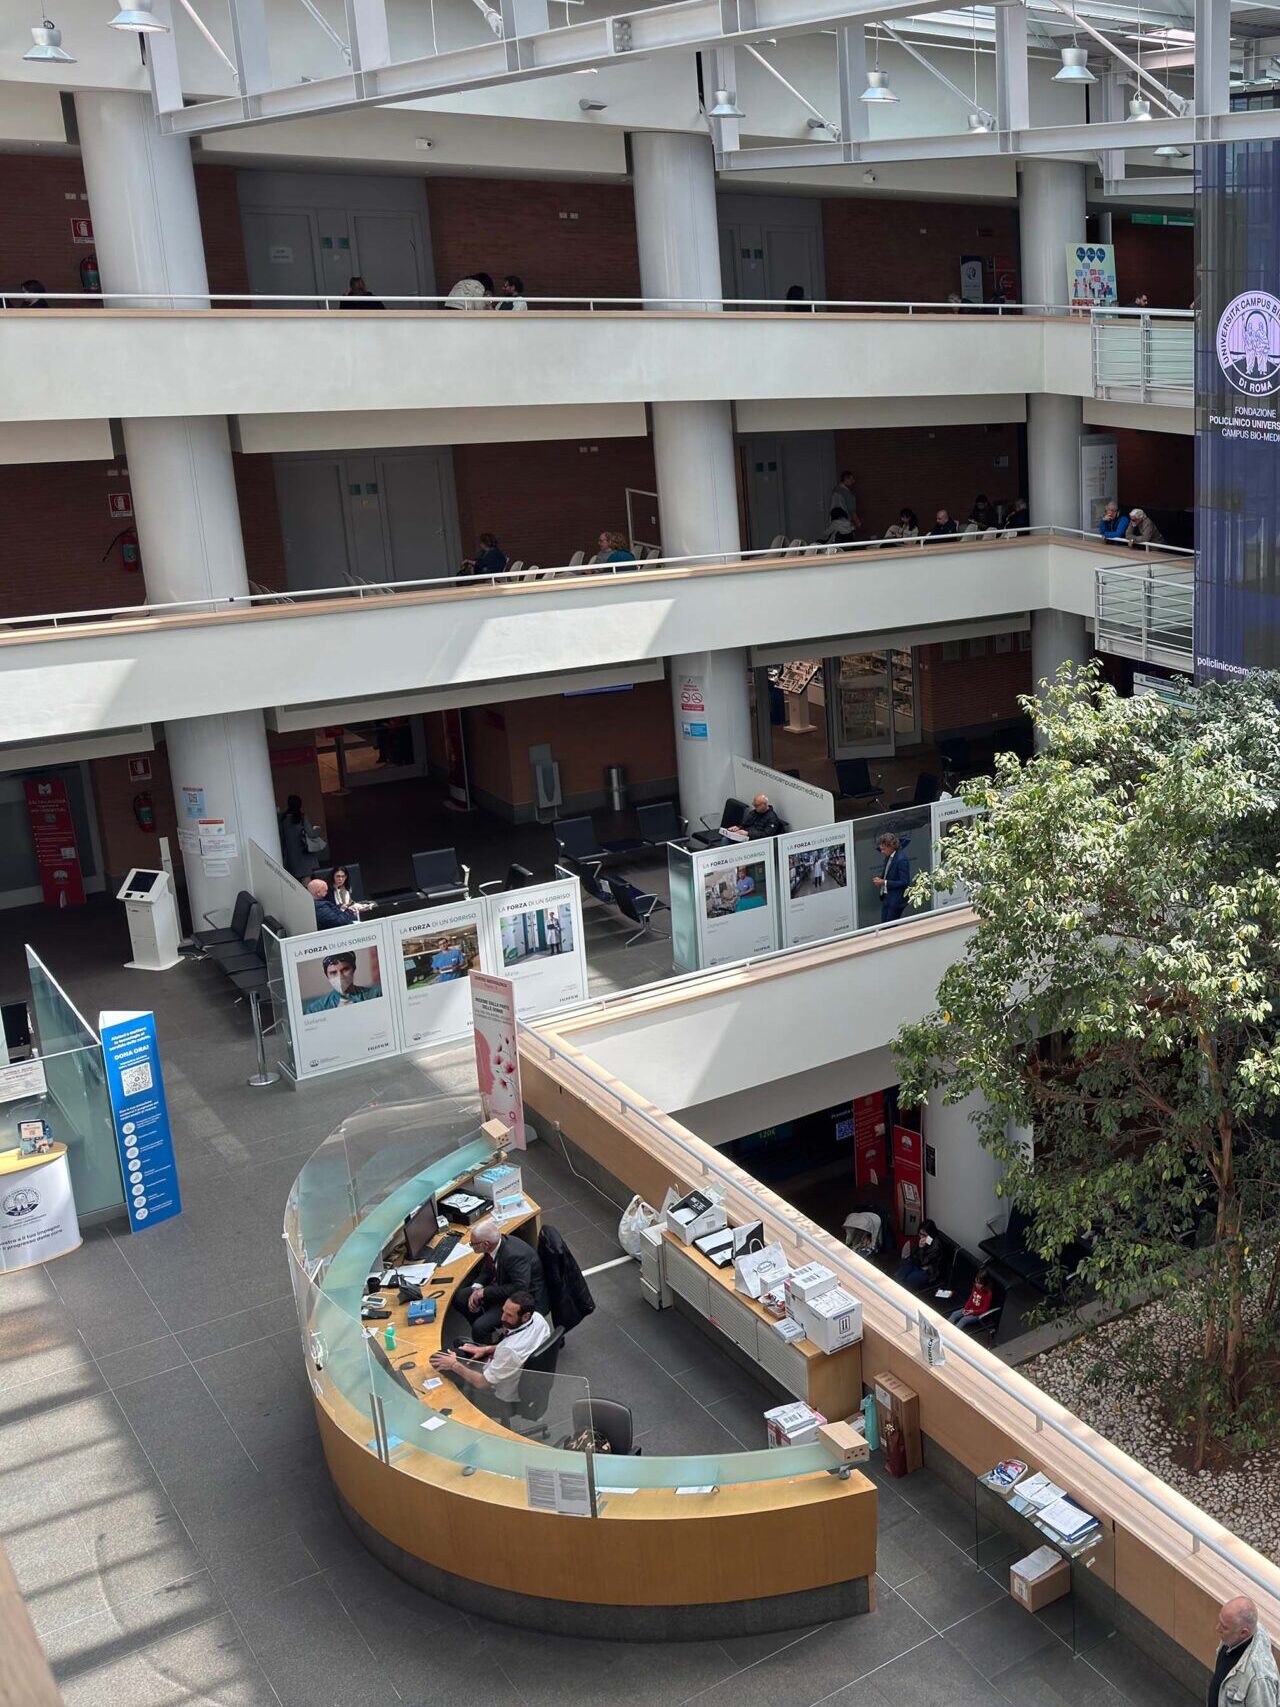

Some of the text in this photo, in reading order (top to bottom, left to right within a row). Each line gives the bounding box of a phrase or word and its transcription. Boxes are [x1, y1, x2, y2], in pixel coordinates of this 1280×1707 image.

[1240, 296, 1272, 310] CAMPUS
[1238, 377, 1273, 393] DI ROMA
[1234, 406, 1276, 418] FONDAZIONE
[1210, 416, 1250, 428] POLICLINICO
[1222, 428, 1250, 440] CAMPUS
[944, 808, 960, 817] FORZA
[794, 840, 812, 850] FORZA
[824, 832, 846, 843] SORRISO
[710, 858, 728, 868] FORZA
[744, 850, 767, 861] SORRISO
[506, 901, 528, 912] FORZA
[535, 898, 545, 906] UN
[545, 892, 571, 903] SORRISO
[408, 922, 431, 933] FORZA
[438, 918, 450, 927] UN
[450, 912, 477, 924] SORRISO
[304, 944, 328, 955] FORZA
[336, 940, 348, 949] UN
[348, 934, 377, 946] SORRISO
[114, 1050, 133, 1060] DONA
